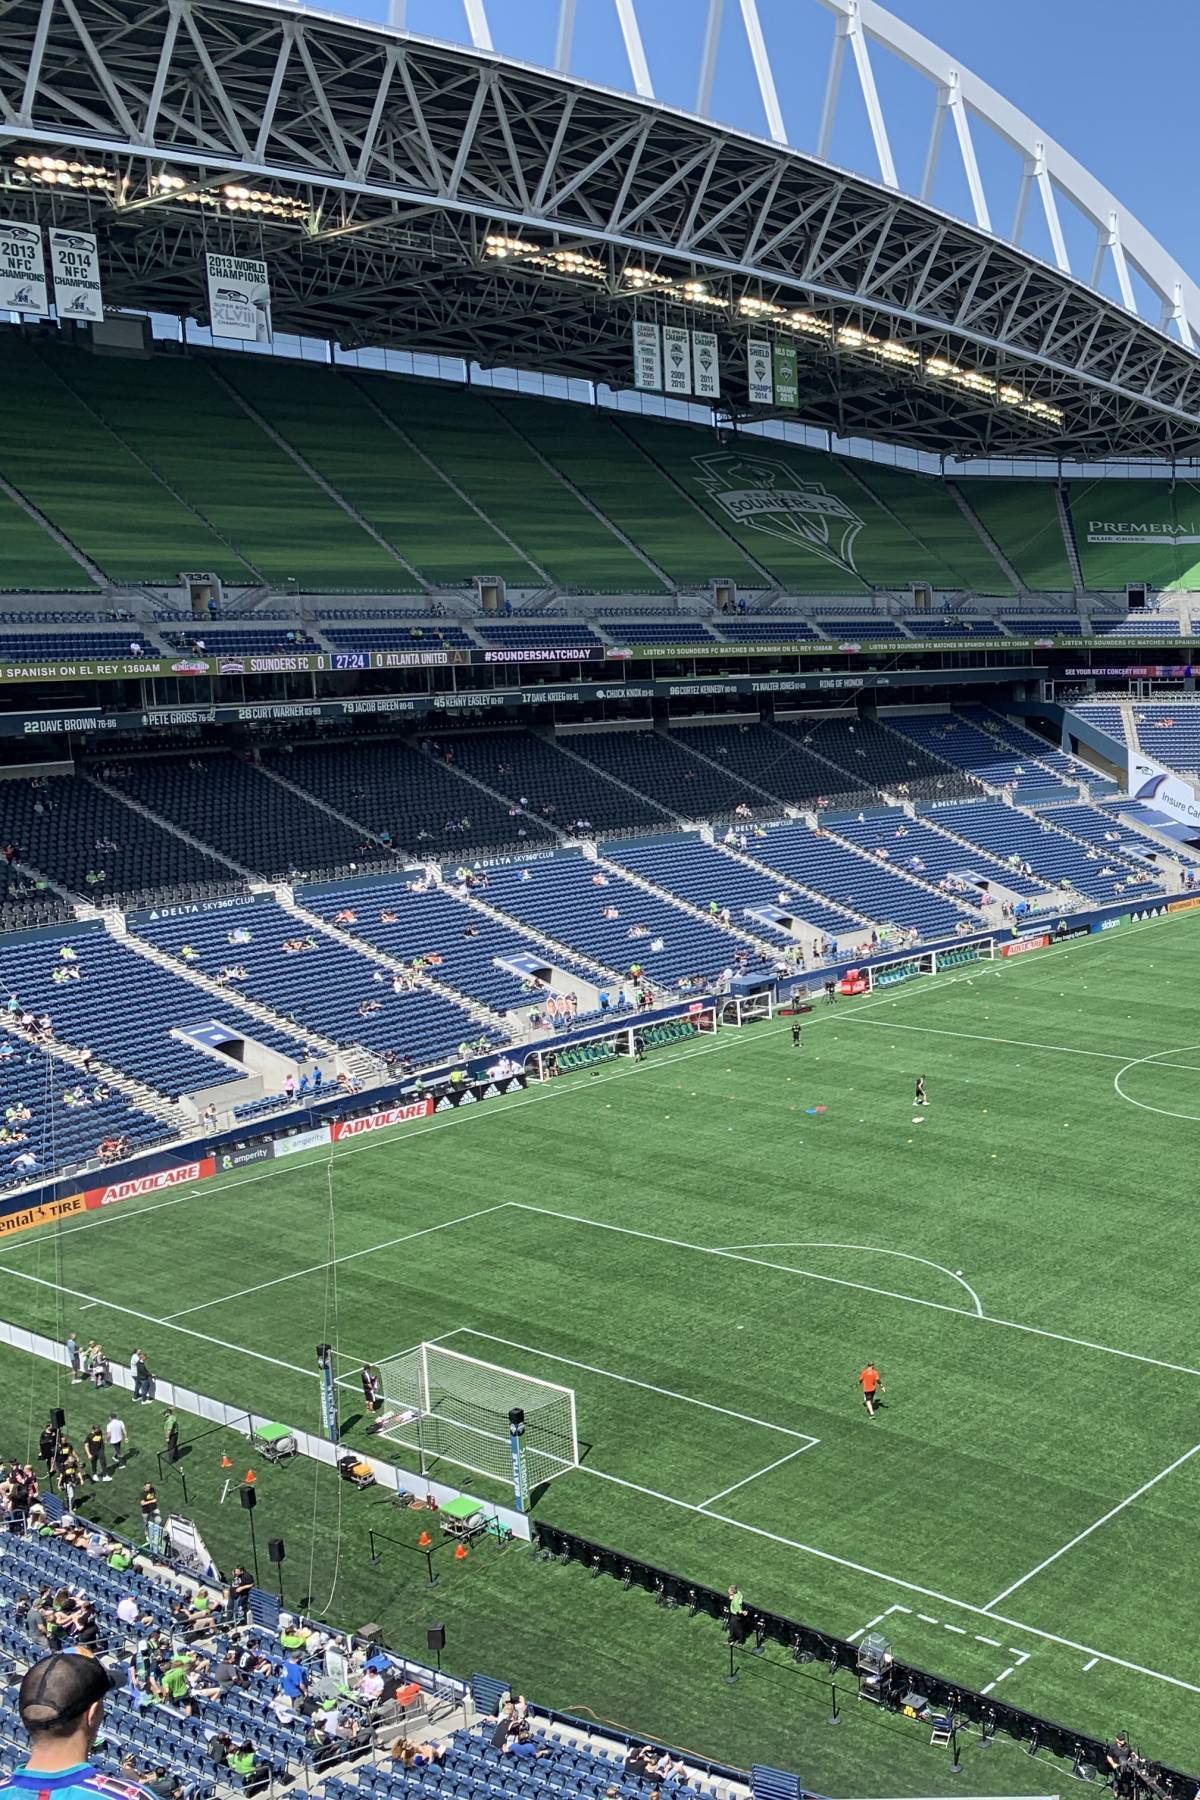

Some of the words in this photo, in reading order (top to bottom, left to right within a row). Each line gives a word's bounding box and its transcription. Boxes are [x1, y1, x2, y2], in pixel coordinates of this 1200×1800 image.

[2, 242, 36, 259] 2013
[8, 257, 32, 271] NFC
[59, 250, 92, 268] 2014
[208, 256, 233, 269] 2013
[234, 259, 265, 274] WORLD
[64, 265, 88, 280] NFC
[209, 266, 266, 284] CHAMPIONS
[54, 276, 101, 291] CHAMPIONS
[749, 348, 769, 358] SHIELD
[700, 374, 713, 383] 2011
[701, 384, 714, 392] 2014
[754, 392, 768, 400] 2014
[729, 497, 818, 513] SOUNDERS
[818, 501, 843, 515] FC
[1089, 521, 1187, 534] PREMERA
[677, 647, 709, 655] SOUNDERS
[251, 658, 297, 671] SOUNDERS
[298, 657, 308, 669] FC
[318, 657, 324, 668] 0
[336, 655, 364, 668] 27:24
[377, 655, 383, 666] 0
[386, 653, 420, 666] ATLANTA
[421, 653, 447, 664] UNITED
[485, 649, 591, 662] #SOUNDERSMATCHDAY
[7, 665, 57, 678] SPANISH
[60, 665, 76, 675] ON
[80, 665, 94, 675] EL
[97, 665, 118, 675] REY
[122, 664, 160, 673] 1360AM
[1065, 668, 1076, 676] SEE
[1076, 668, 1091, 676] YOUR
[843, 678, 863, 687] HONOR
[606, 688, 625, 698] CHUCK
[626, 688, 641, 697] KNOX
[670, 686, 679, 695] 96
[680, 685, 699, 695] CORTEZ
[700, 685, 725, 694] KENNEDY
[434, 698, 445, 708] 45
[446, 697, 466, 707] KENNY
[467, 696, 491, 706] EASLEY
[522, 693, 531, 703] 17
[532, 693, 546, 702] DAVE
[547, 692, 566, 702] KRIEG
[239, 709, 252, 719] 28
[252, 707, 273, 719] CURT
[275, 706, 304, 717] WARNER
[342, 703, 354, 713] 79
[354, 702, 376, 713] JACOB
[377, 701, 399, 712] GREEN
[149, 714, 168, 725] PETE
[169, 713, 197, 724] GROSS
[24, 721, 40, 733] 22
[40, 720, 62, 732] DAVE
[64, 719, 97, 731] BROWN
[1162, 791, 1186, 812] Insure
[482, 856, 511, 868] DELTA
[162, 904, 199, 918] DELTA
[49, 1199, 81, 1216] TIRE
[101, 1164, 199, 1205] ADVOCARE
[234, 1148, 268, 1166] amperity
[291, 1133, 325, 1151] amperity
[339, 1103, 428, 1139] ADVOCARE
